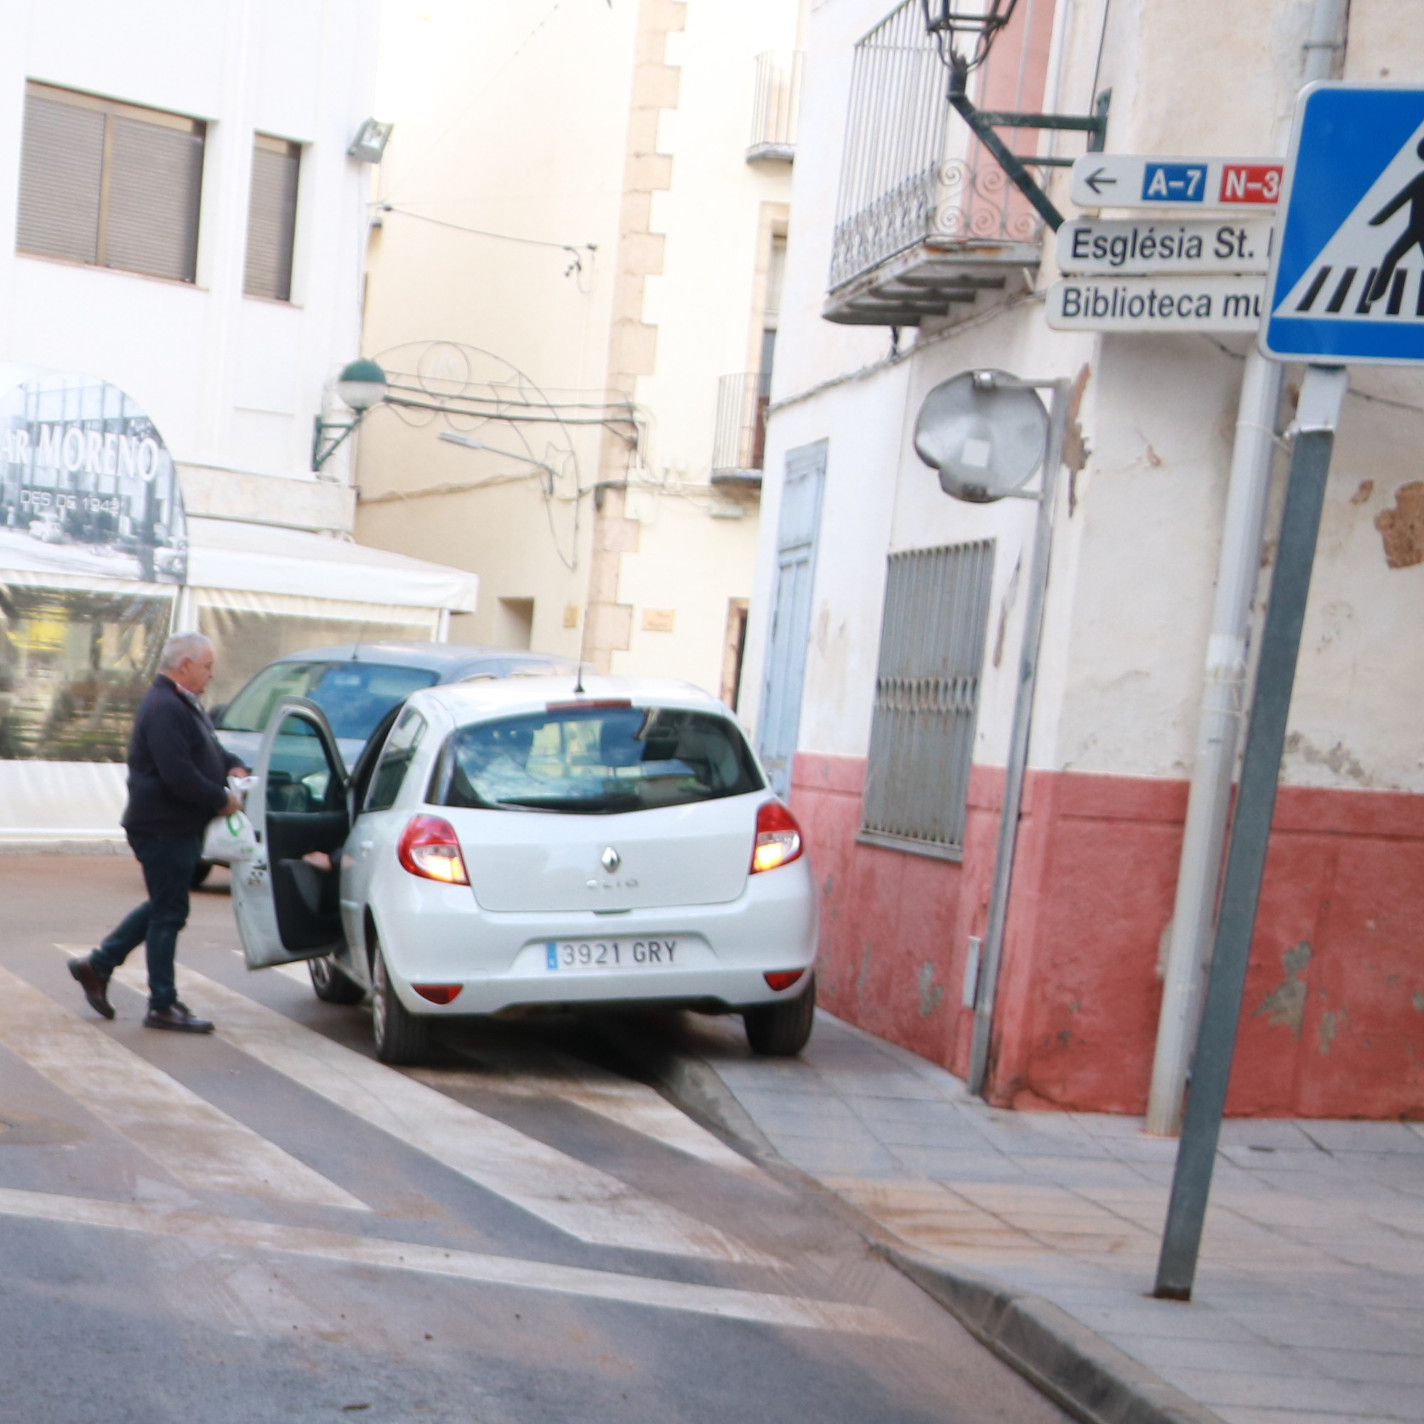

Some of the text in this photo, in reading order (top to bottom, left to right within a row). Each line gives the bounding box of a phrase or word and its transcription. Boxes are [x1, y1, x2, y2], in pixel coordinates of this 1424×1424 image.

[1147, 168, 1283, 199] A-7 N-3
[1071, 226, 1202, 267] Església
[1214, 225, 1254, 259] St.
[1061, 286, 1211, 318] Biblioteca
[38, 423, 159, 483] MORENO
[562, 942, 621, 966] 3921
[633, 940, 676, 964] GRY
